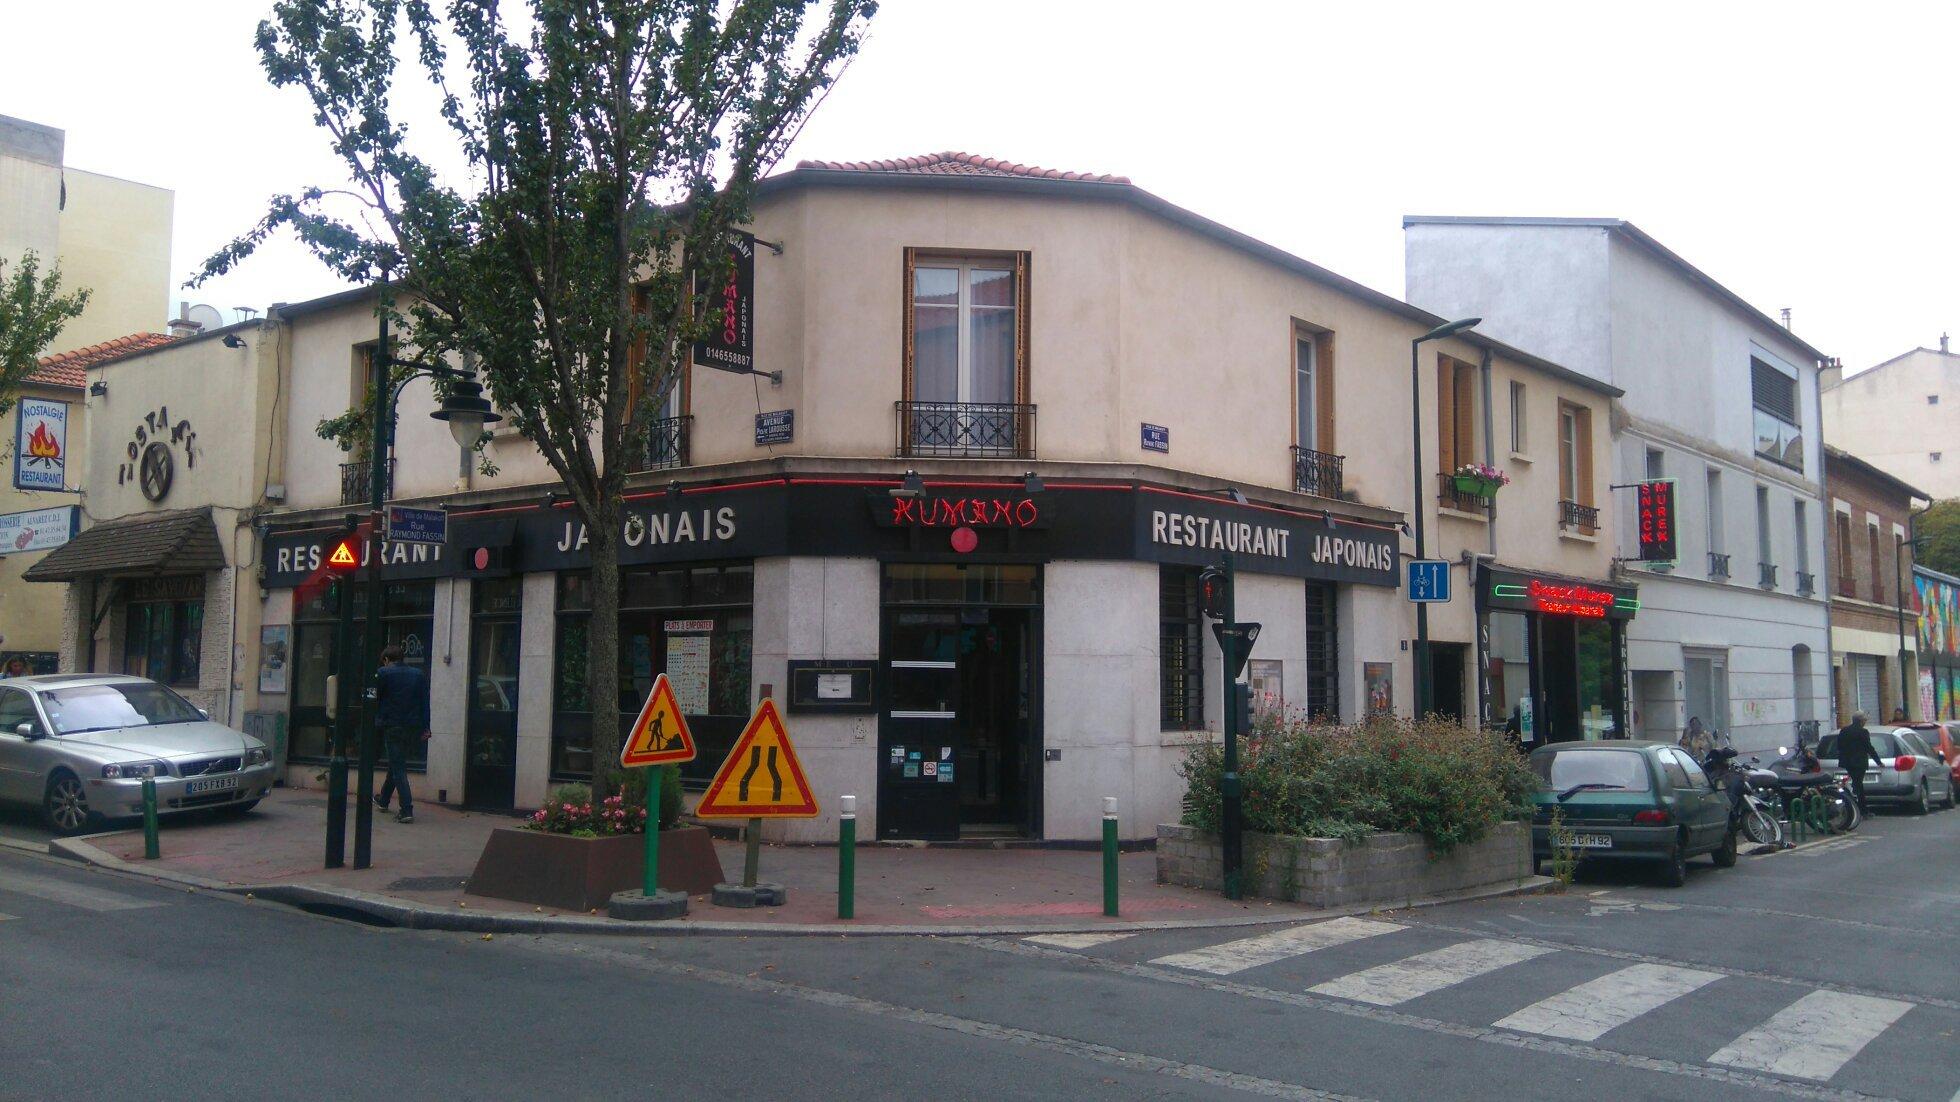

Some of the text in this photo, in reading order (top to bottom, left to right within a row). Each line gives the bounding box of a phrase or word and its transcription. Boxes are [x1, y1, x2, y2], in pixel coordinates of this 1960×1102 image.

[23, 405, 64, 422] NOSTALGIE
[763, 416, 784, 426] AVENUE
[21, 470, 62, 484] RESTAURANT
[893, 497, 1038, 527] KUMANO
[1641, 482, 1653, 543] SNACK
[390, 529, 445, 541] RAYMOND FASSIN
[411, 521, 425, 531] Rue
[557, 506, 737, 552] JAONAIS
[1152, 510, 1392, 571] RESTAURANT JAPONAIS
[277, 540, 441, 573] RESURANT
[665, 621, 680, 630] PLATS
[685, 620, 713, 629] EMPORTER
[1482, 624, 1491, 722] SNAC
[1621, 633, 1630, 739] TRAITEUR
[1598, 836, 1610, 846] 92
